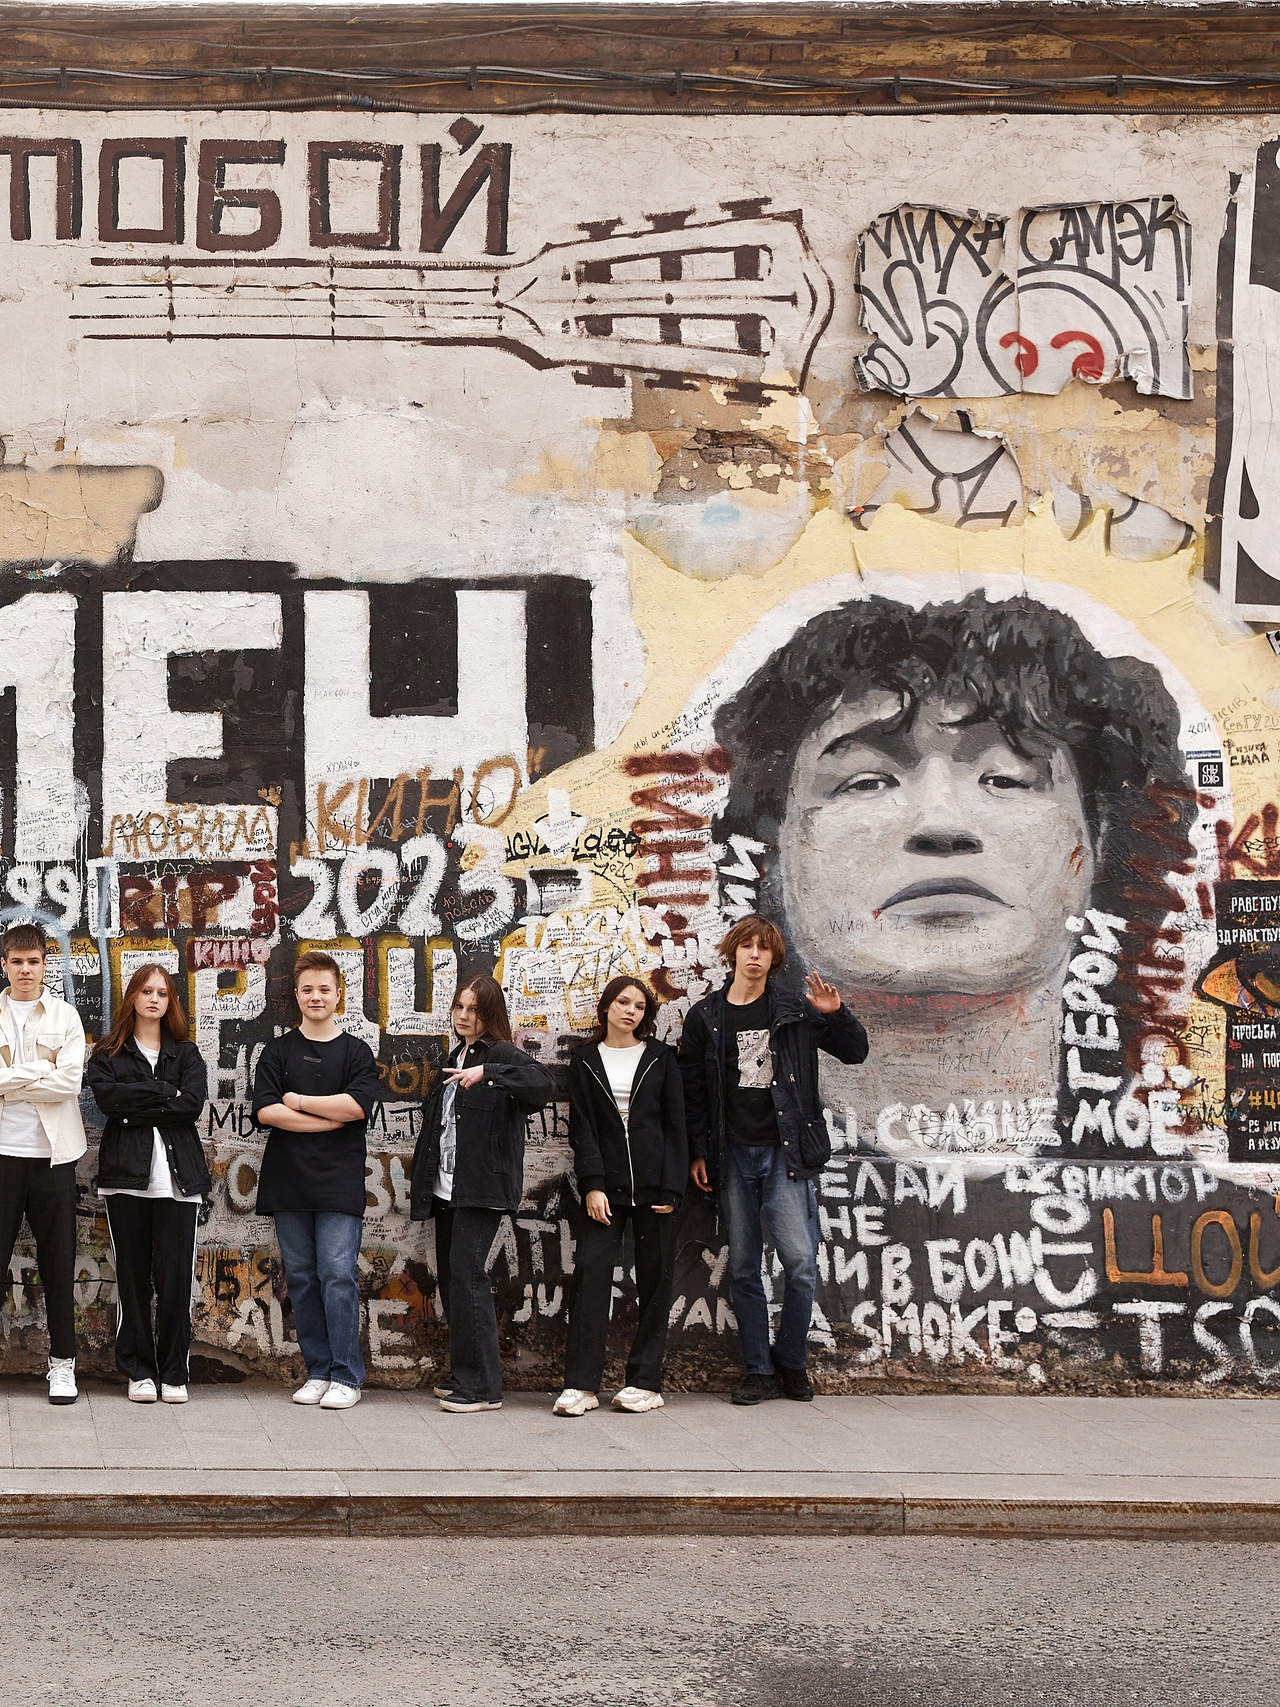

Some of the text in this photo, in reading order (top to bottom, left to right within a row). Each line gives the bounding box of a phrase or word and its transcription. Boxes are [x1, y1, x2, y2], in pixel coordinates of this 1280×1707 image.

[290, 824, 516, 942] 2023
[195, 940, 270, 968] КИНО
[1232, 1023, 1277, 1042] ПРОСЬБА
